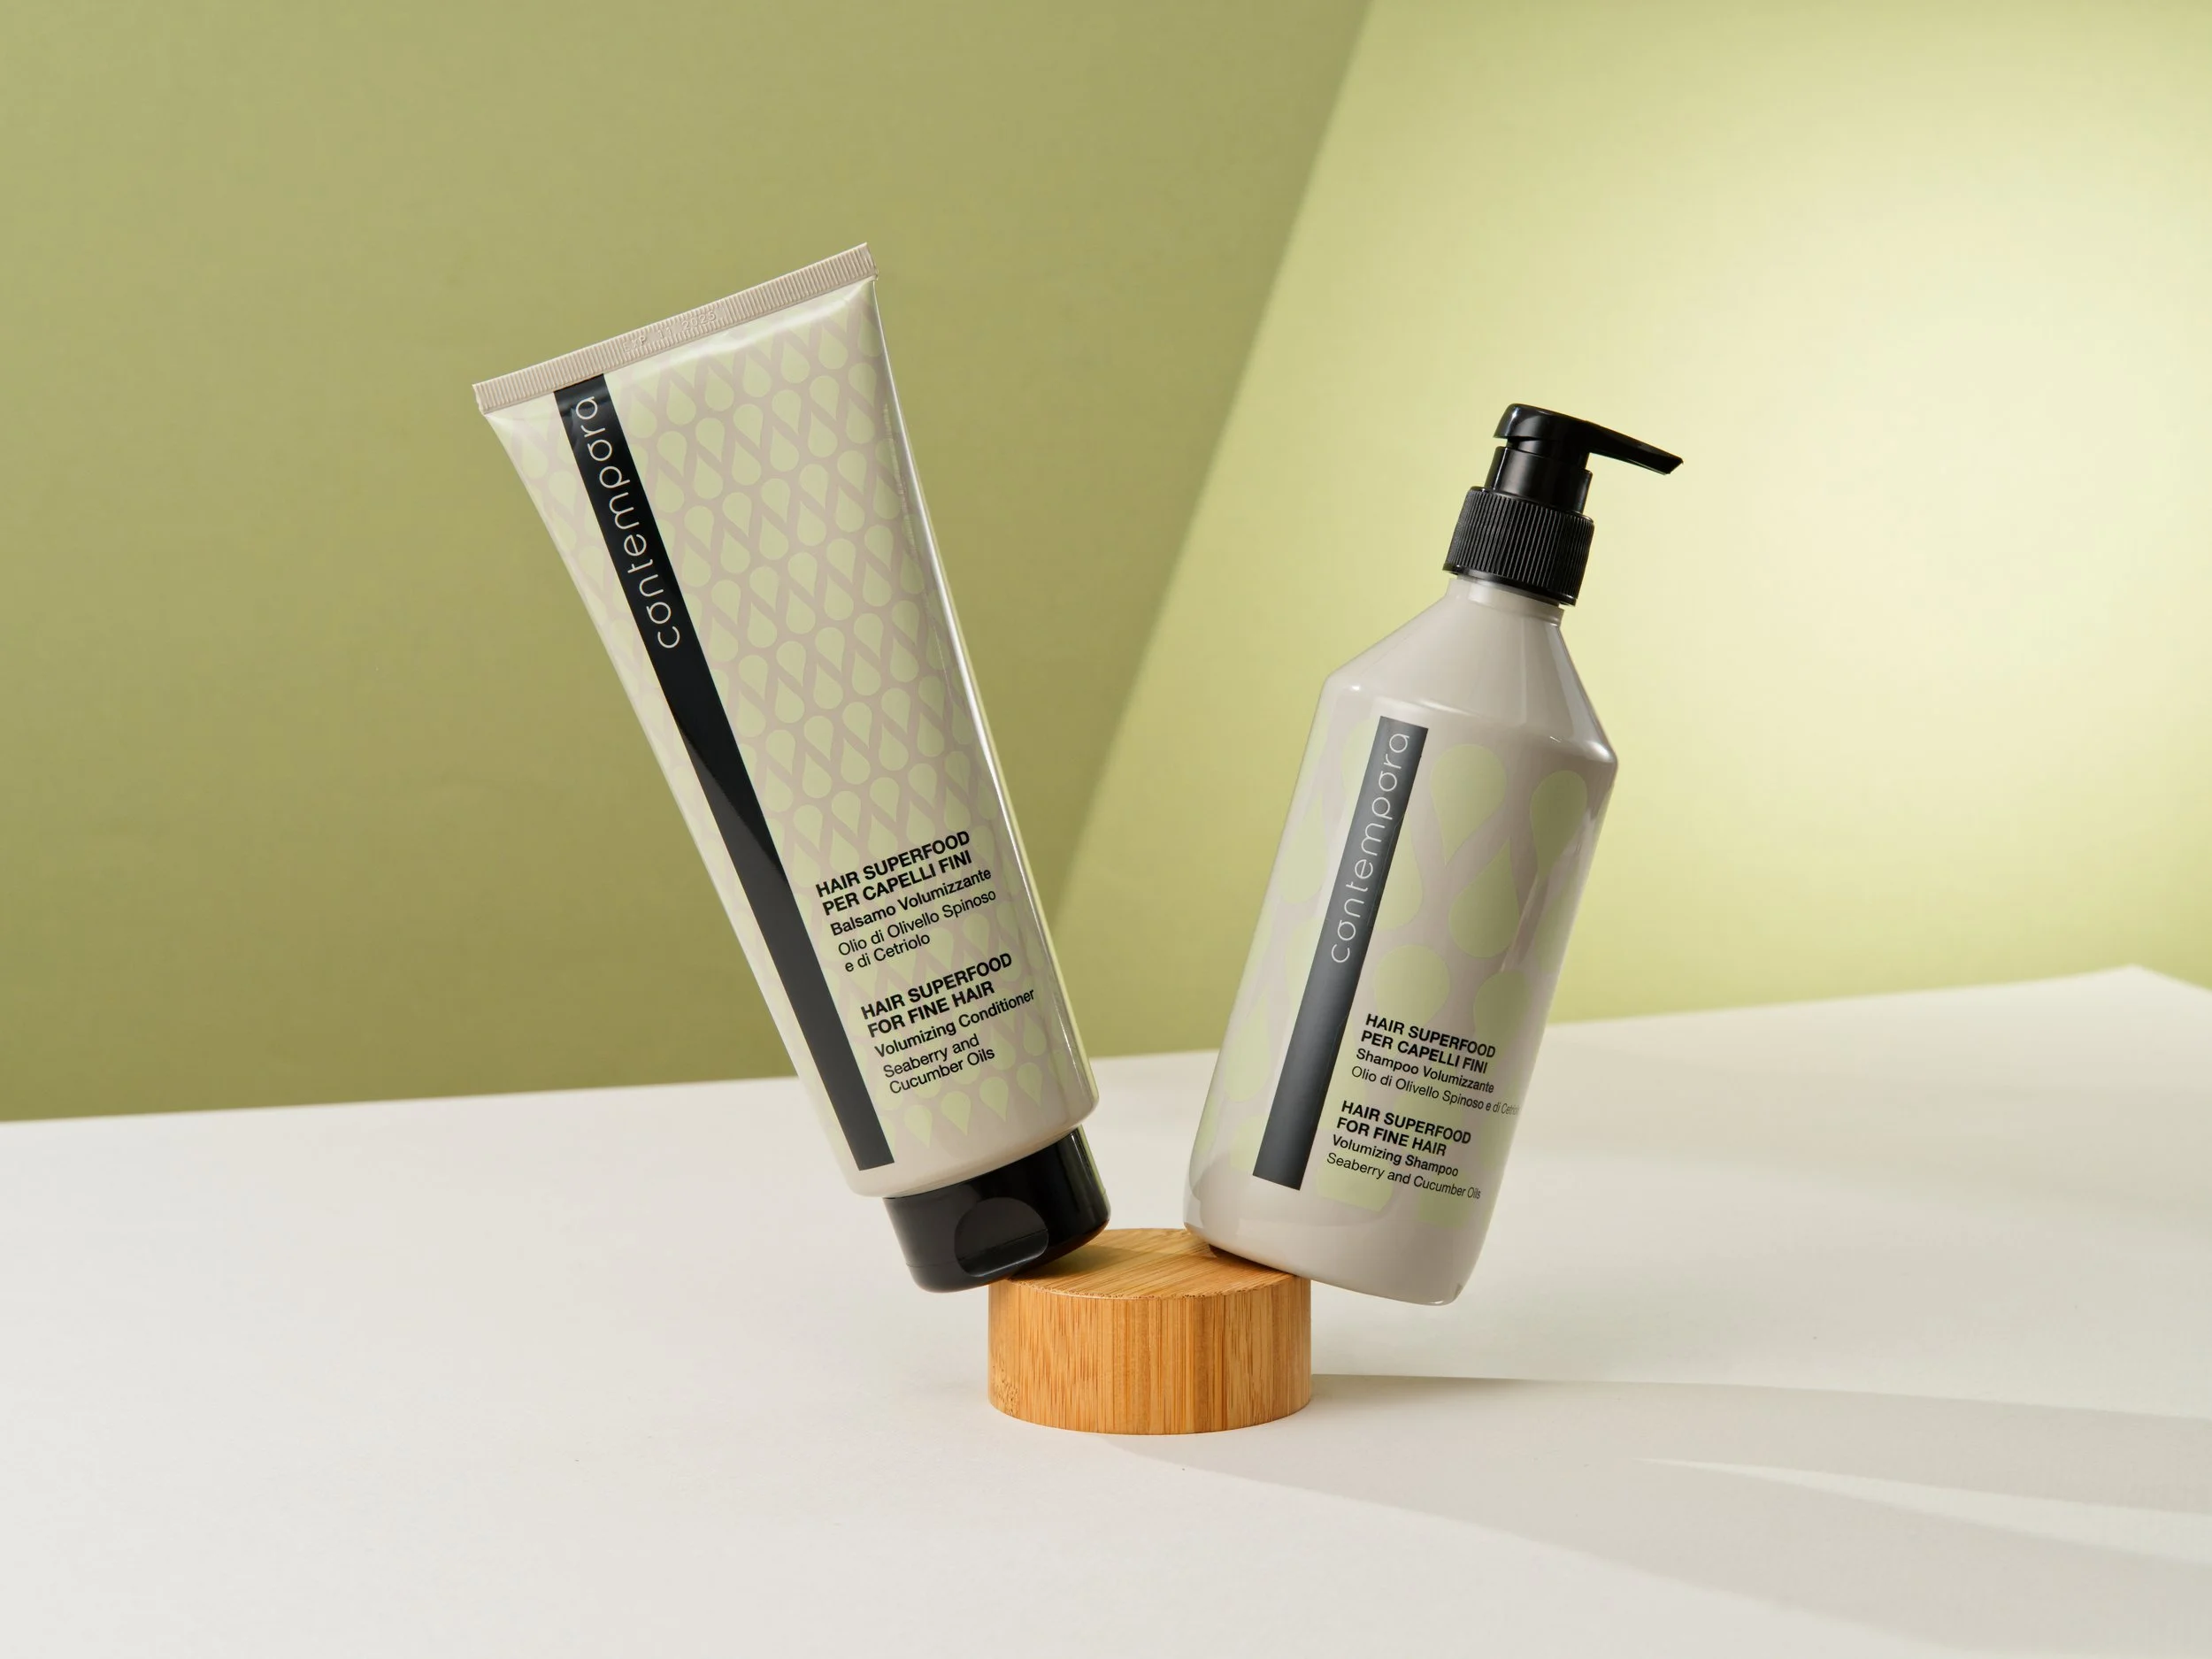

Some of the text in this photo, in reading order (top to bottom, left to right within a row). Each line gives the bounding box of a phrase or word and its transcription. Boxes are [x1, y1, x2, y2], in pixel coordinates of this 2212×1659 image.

[816, 831, 971, 897] HAIR SUPERFOOD
[822, 850, 972, 916] PER CAPELLI FINI
[830, 868, 992, 936] Balsamo Volumizzante
[838, 890, 996, 956] Olio di Olivello Spinoso
[845, 933, 931, 972] e di Cetriolo
[861, 953, 1012, 1019] HAIR SUPERFOOD
[867, 981, 995, 1038] FOR FINE HAIR
[875, 988, 1034, 1057] Volumizing Conditioner
[883, 1033, 979, 1078] Seaberry and
[1361, 1030, 1488, 1073] PER CAPELLI FINI
[1365, 1013, 1496, 1058] HAIR SUPERFOOD
[889, 1048, 995, 1094] Cucumber Oils
[1351, 1066, 1377, 1082] Olio
[1380, 1075, 1392, 1087] di
[1395, 1079, 1439, 1099] Olivello
[1442, 1090, 1484, 1110] Spinoso
[1486, 1102, 1492, 1111] e
[1493, 1102, 1501, 1113] di
[1356, 1048, 1494, 1094] Shampoo Volumizzante
[1336, 1117, 1447, 1156] FOR FINE HAIR
[1341, 1100, 1471, 1145] HAIR SUPERFOOD
[1326, 1152, 1481, 1200] Seaberry and Cucumber Oils
[1333, 1134, 1459, 1177] Volumizing Shampoo
